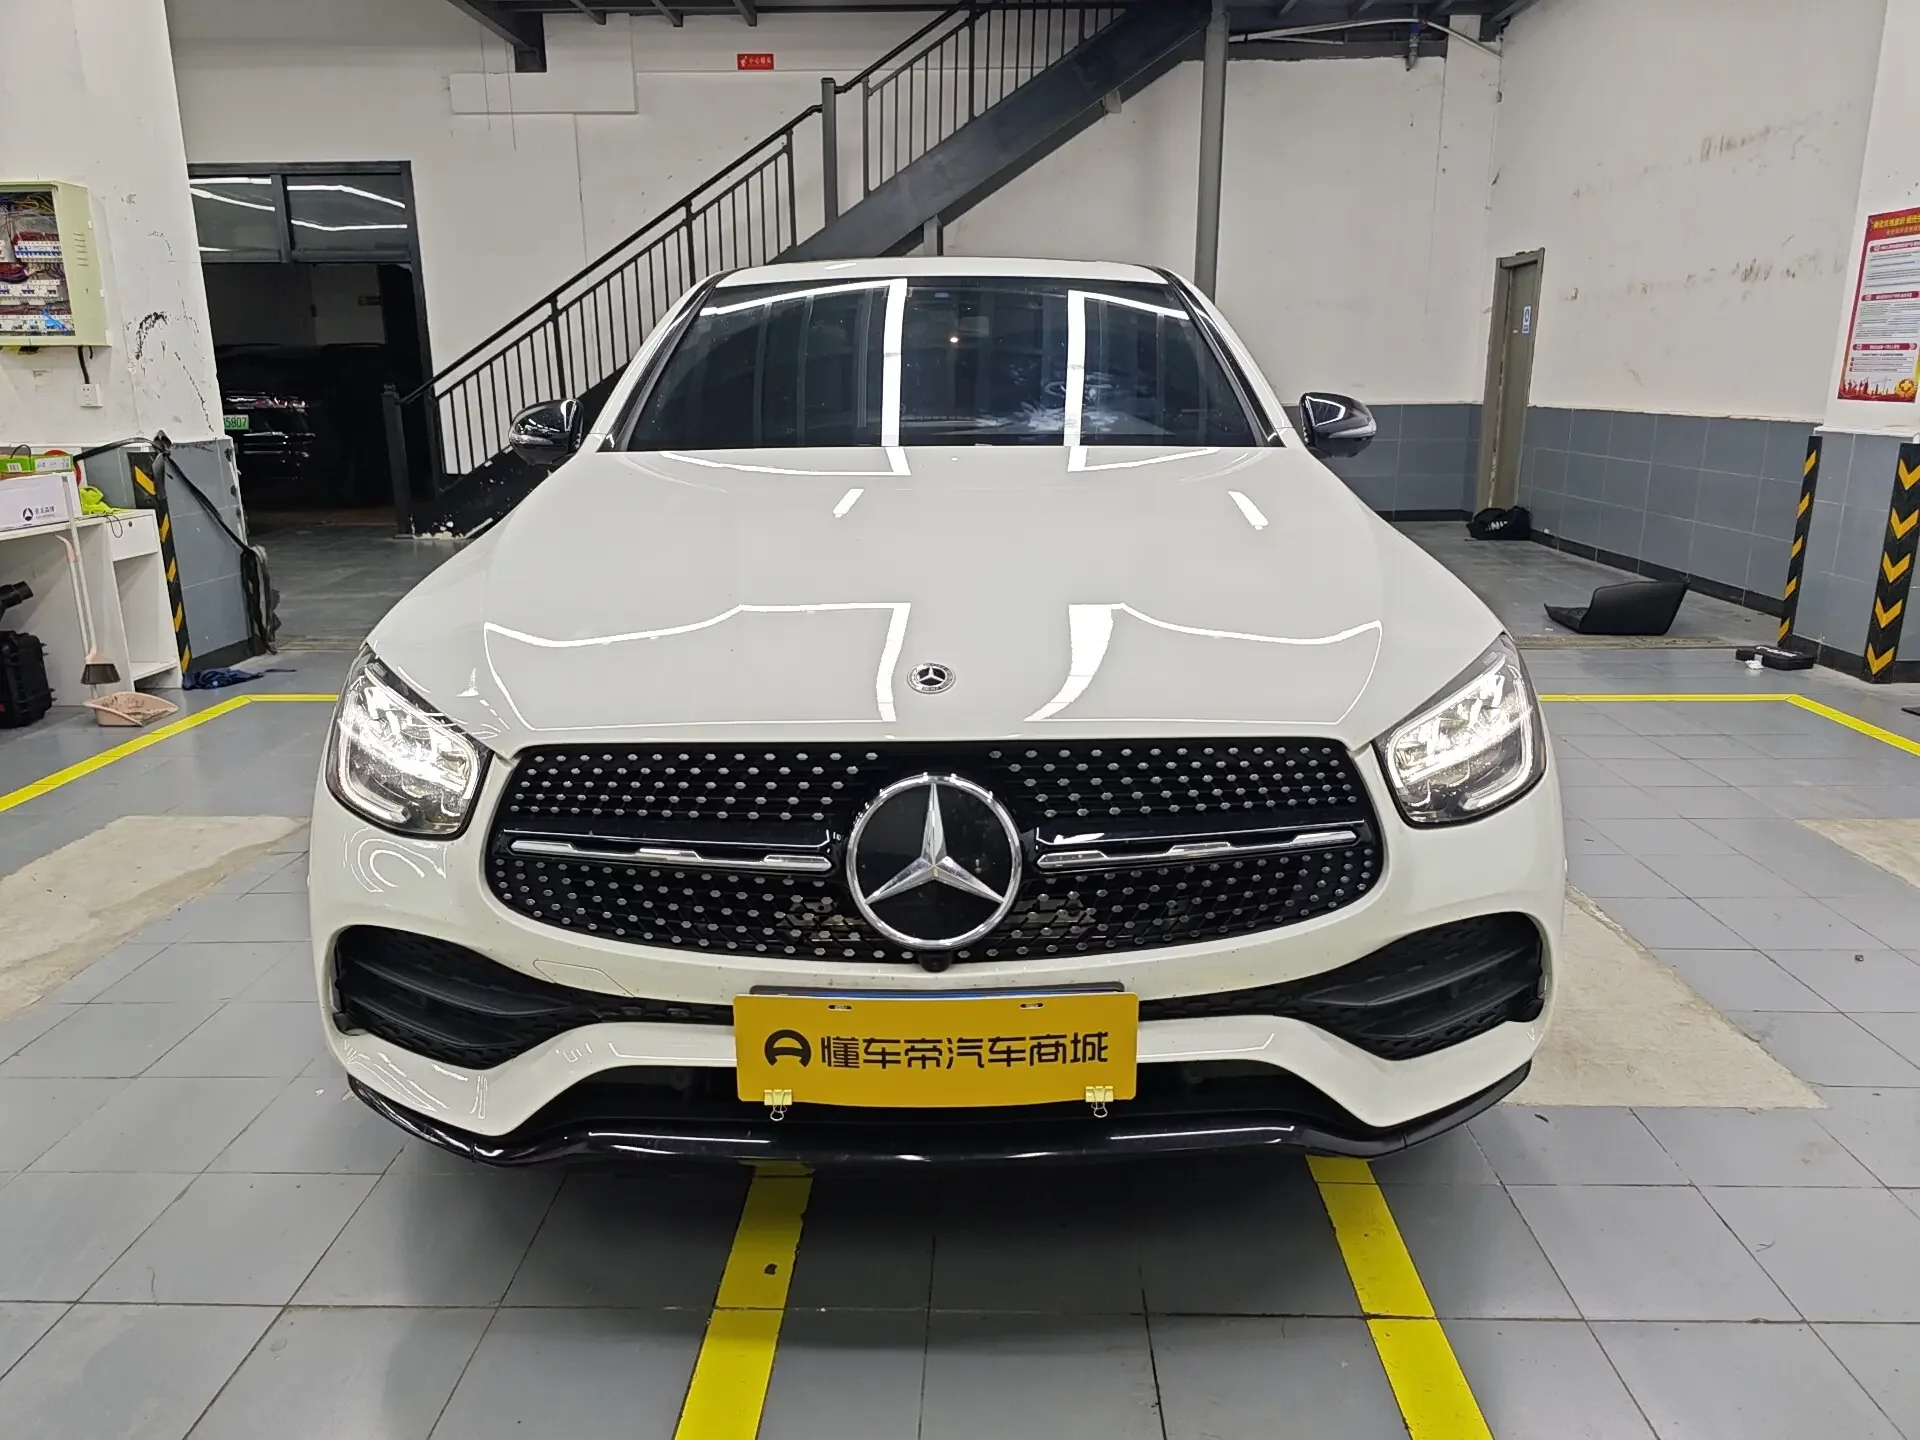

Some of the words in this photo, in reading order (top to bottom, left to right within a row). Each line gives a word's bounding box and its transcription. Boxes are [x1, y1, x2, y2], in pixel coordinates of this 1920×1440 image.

[223, 417, 247, 428] 5807
[820, 1031, 1109, 1069] 懂车帝汽车商城
